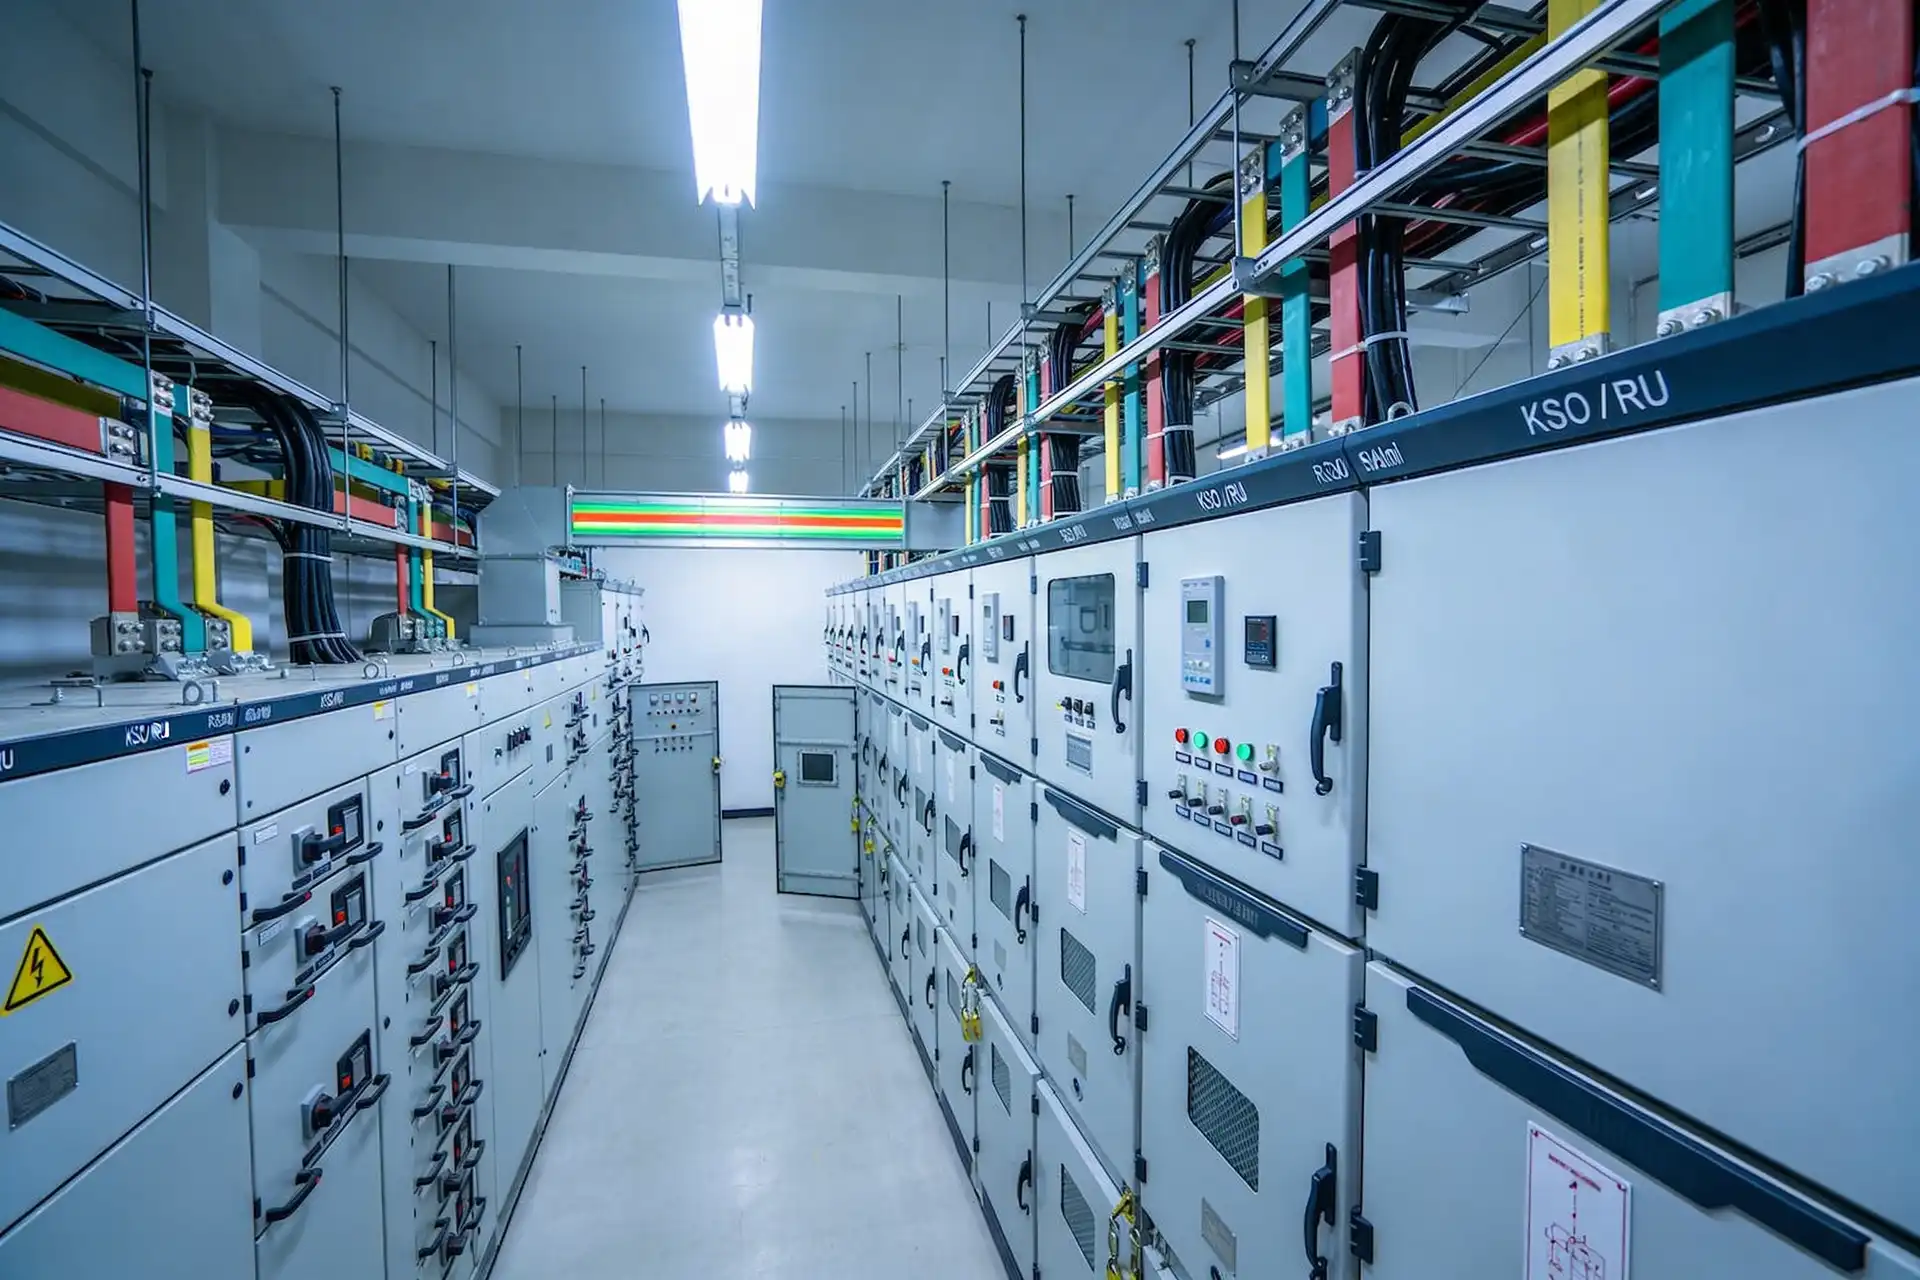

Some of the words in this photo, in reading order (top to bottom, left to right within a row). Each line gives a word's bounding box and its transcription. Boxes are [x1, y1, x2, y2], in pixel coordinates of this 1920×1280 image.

[1519, 391, 1591, 436] KSO
[1195, 489, 1221, 512] KSO
[0, 748, 14, 772] U
